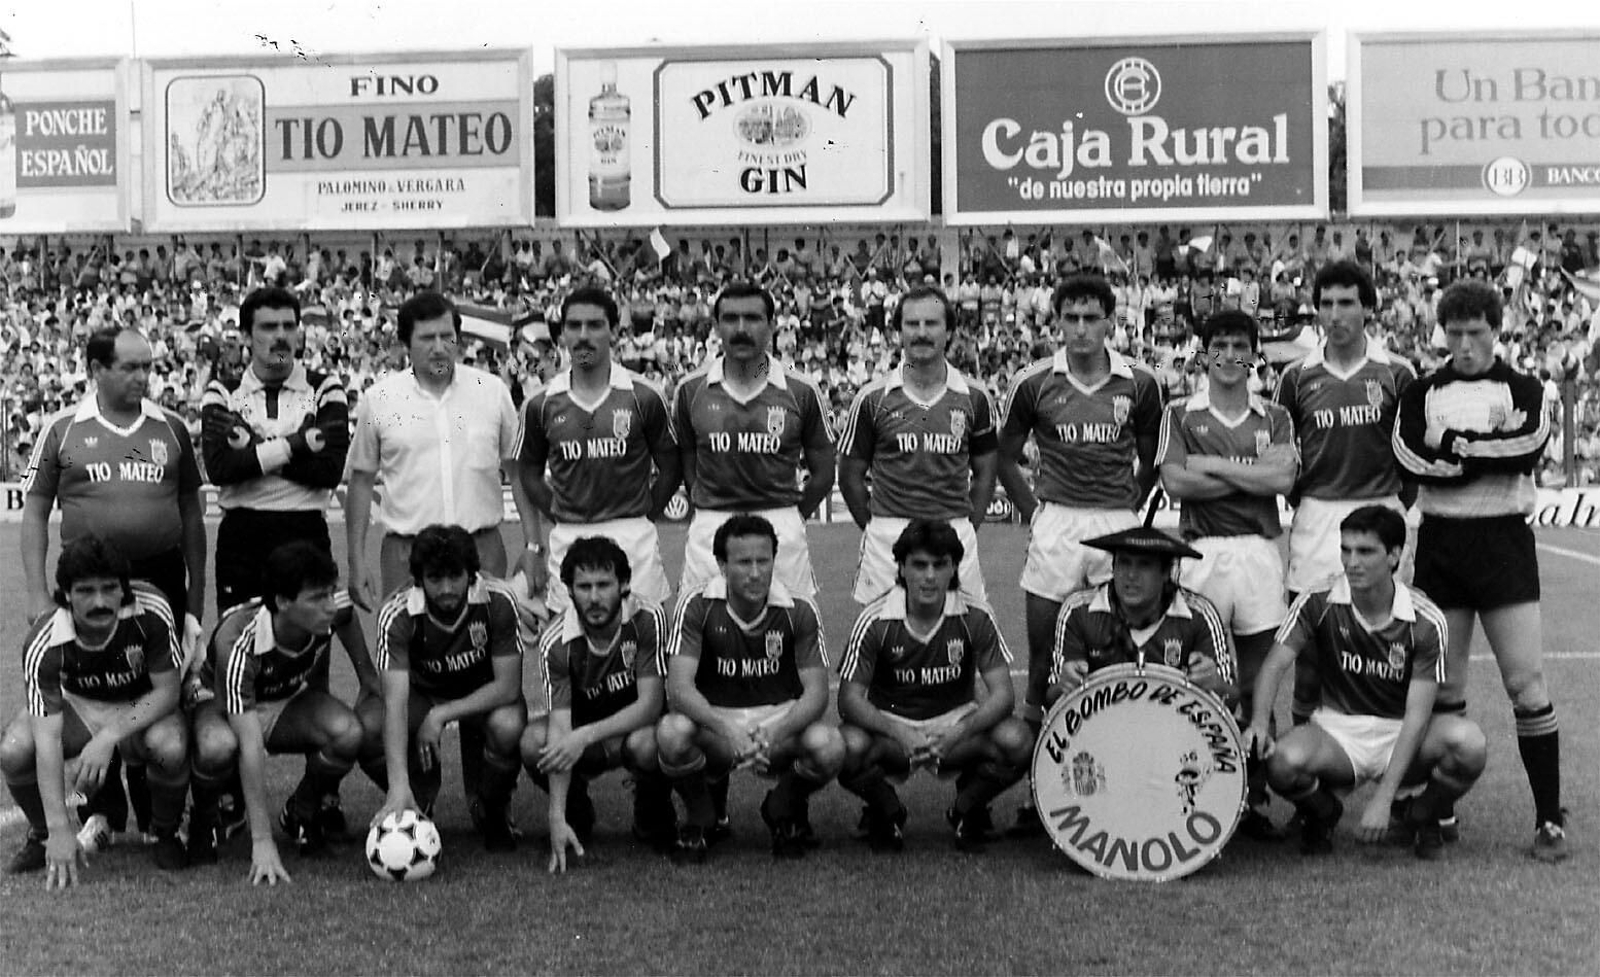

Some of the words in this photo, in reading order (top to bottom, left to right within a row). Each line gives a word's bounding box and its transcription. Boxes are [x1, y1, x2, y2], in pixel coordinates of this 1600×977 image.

[350, 75, 440, 96] FINO
[691, 70, 857, 120] PITMAN
[1435, 68, 1498, 103] Un
[25, 107, 107, 136] PONCHE
[1419, 114, 1522, 155] para
[275, 116, 344, 160] TIO
[362, 111, 513, 158] MATEO
[981, 117, 1113, 180] Caja
[1126, 112, 1290, 167] Rural
[20, 144, 114, 176] ESPAÑOL
[317, 180, 386, 195] PALOMINO
[397, 178, 465, 193] VERGARA
[739, 165, 808, 194] GIN
[1008, 176, 1045, 200] "de
[1049, 176, 1126, 200] nuestra
[1131, 174, 1193, 202] propia
[1197, 172, 1262, 197] tierra"
[341, 201, 378, 213] JEREZ
[392, 200, 444, 211] SHERRY
[1313, 409, 1335, 428] TIO
[1339, 405, 1382, 426] MATEO
[709, 432, 730, 452] TIO
[737, 432, 781, 453] MATEO
[896, 433, 918, 453] TIO
[923, 433, 962, 453] MATEO
[1056, 424, 1078, 442] TIO
[1082, 422, 1121, 443] MATEO
[560, 441, 582, 460] TIO
[586, 437, 627, 458] MATEO
[85, 462, 111, 482] TIO
[119, 462, 164, 484] MATEO
[445, 646, 486, 672] MATEO
[717, 657, 736, 677] TIO
[742, 657, 780, 677] MATEO
[1341, 650, 1362, 674] TIO
[1366, 657, 1405, 683] MATEO
[78, 675, 101, 689] TIO
[893, 668, 915, 683] TIO
[920, 663, 962, 685] MATEO
[1046, 731, 1068, 764] EL
[1065, 681, 1148, 735] BOMBO
[1149, 683, 1185, 705] DE
[1050, 805, 1222, 872] MANOLO
